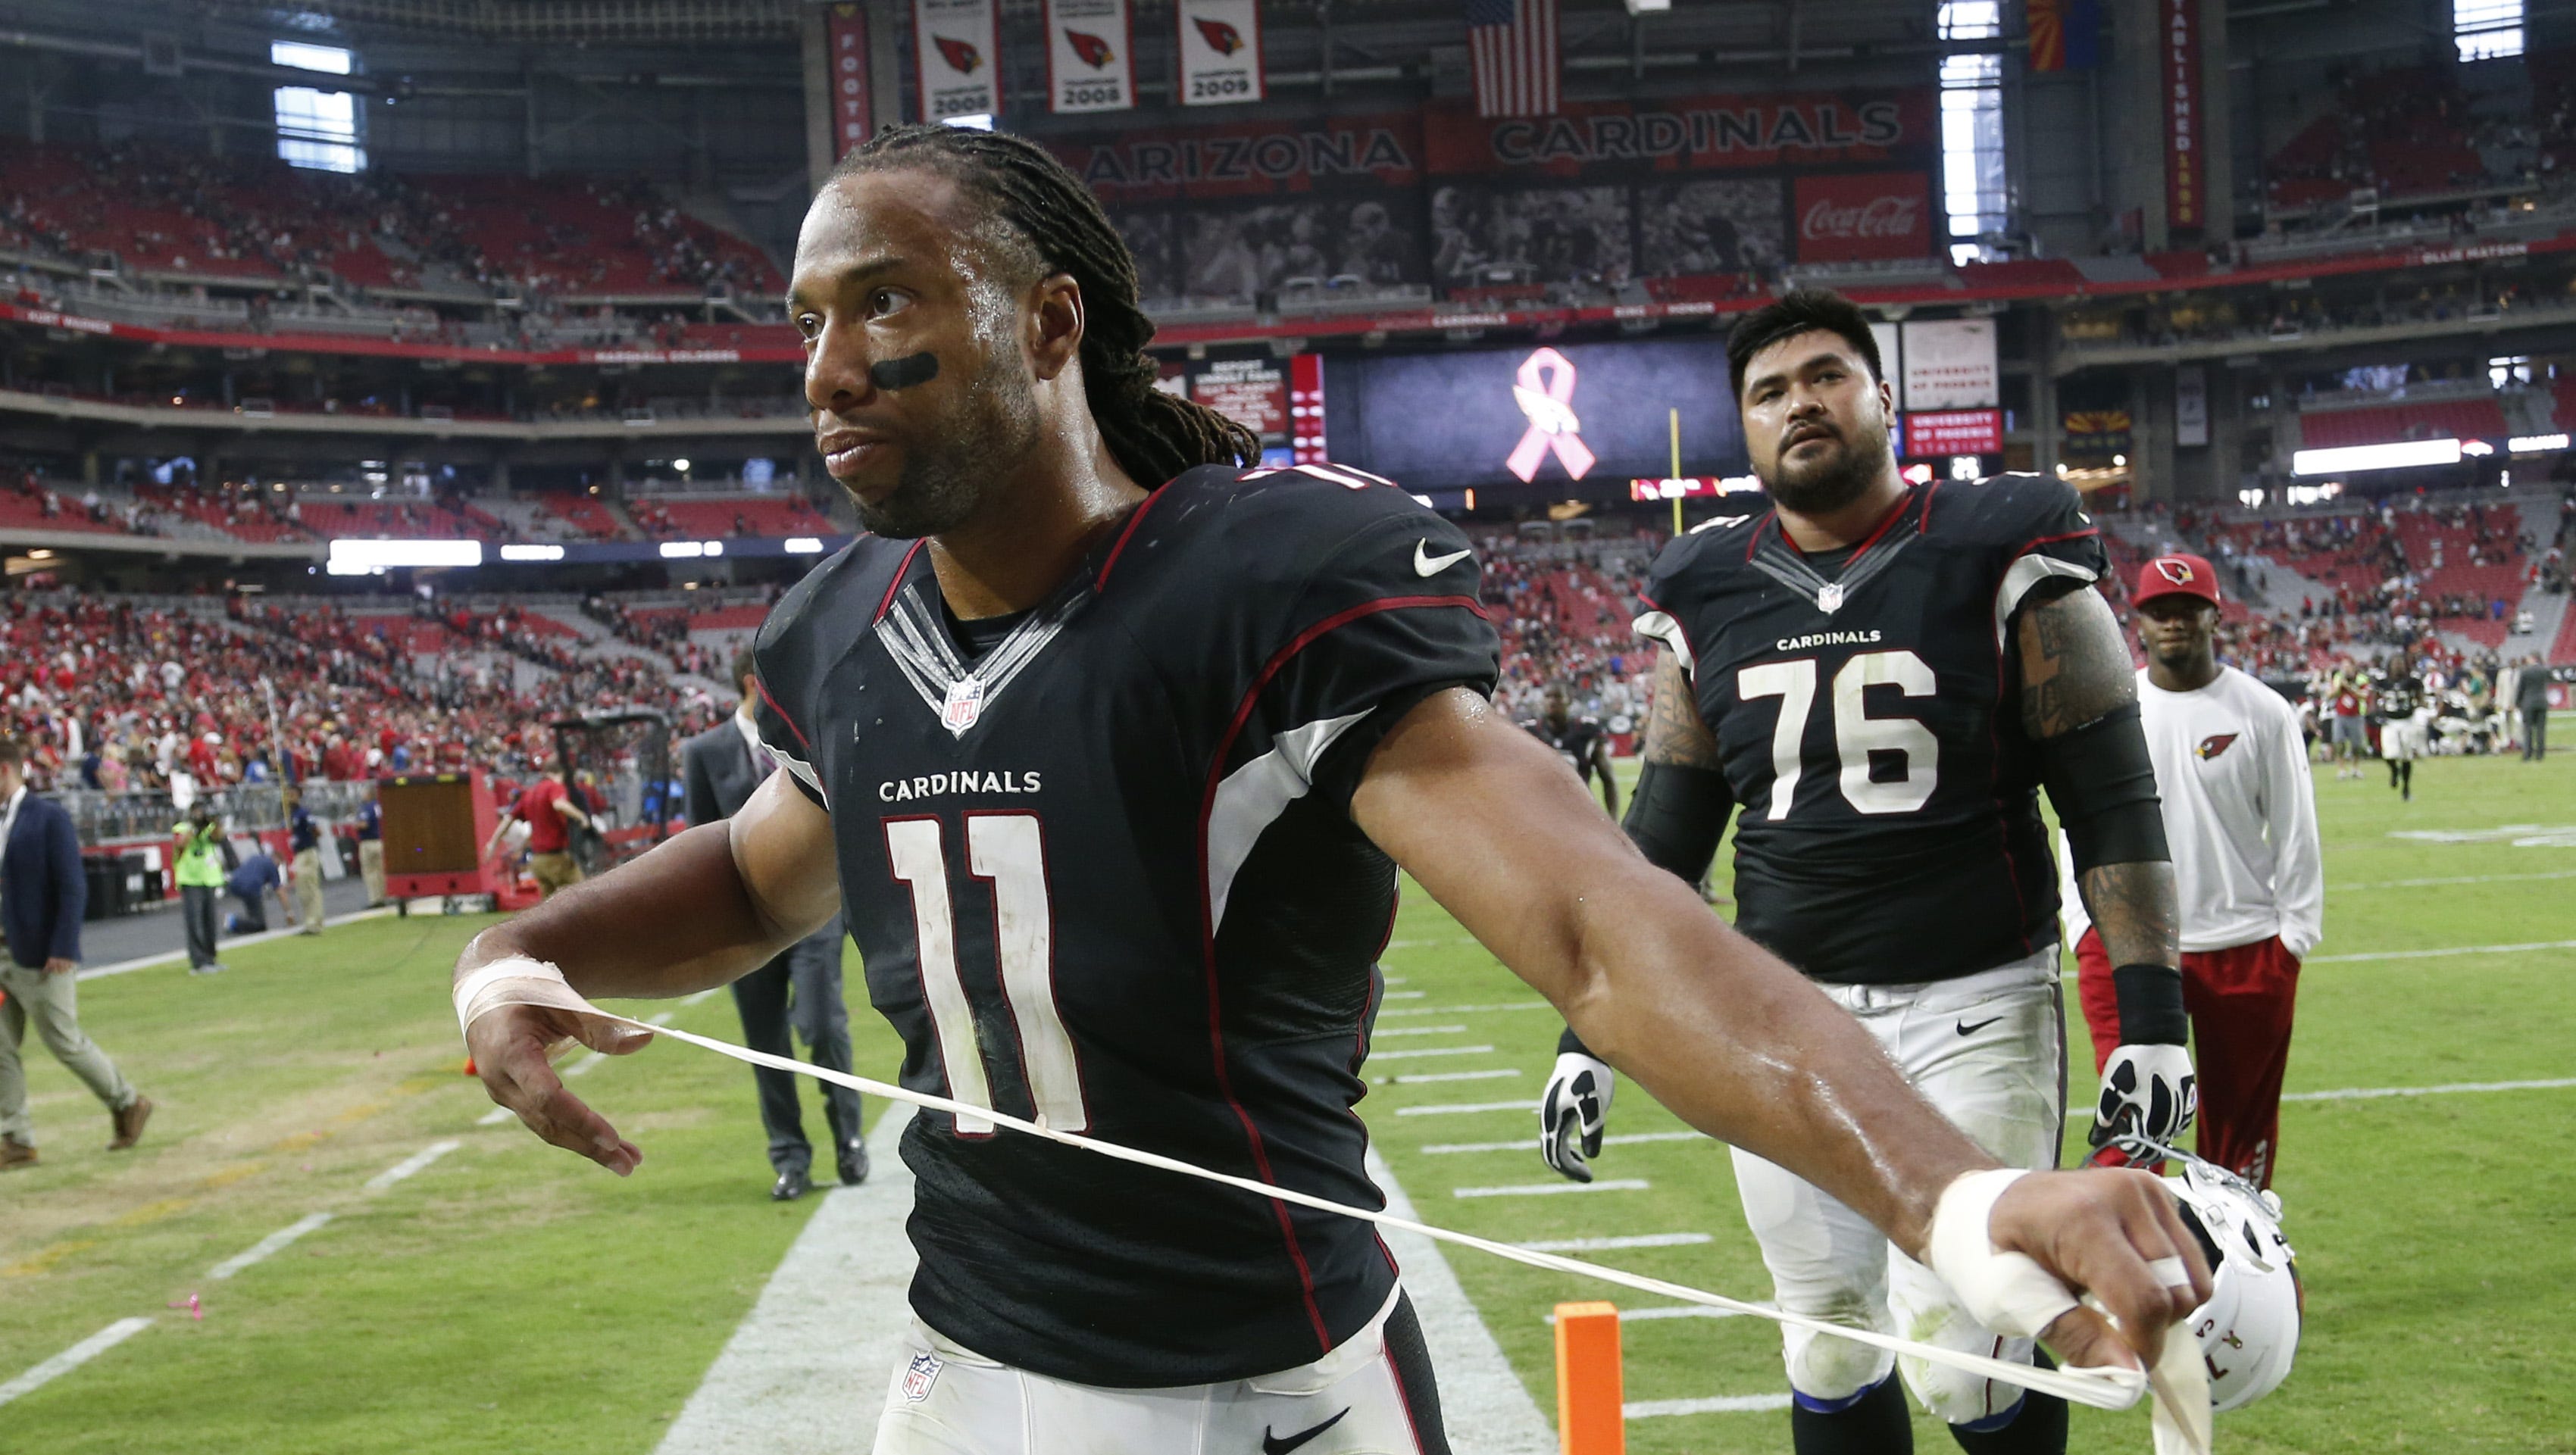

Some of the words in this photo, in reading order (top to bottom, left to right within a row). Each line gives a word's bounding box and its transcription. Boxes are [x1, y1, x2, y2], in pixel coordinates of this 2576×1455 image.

[1064, 87, 1121, 105] 2008
[1193, 79, 1249, 97] 2009
[934, 94, 989, 114] 2008
[1492, 101, 1900, 164] CARDINALS
[1086, 127, 1414, 186] ARIZONA
[1802, 195, 1921, 241] Coca-Cola
[1912, 412, 1993, 428] UNIVERSITY
[1776, 629, 1882, 651] CARDINALS
[949, 701, 975, 723] NFL
[1737, 649, 1939, 821] 76
[879, 770, 1042, 802] CARDINALS
[880, 809, 1092, 1139] 11
[905, 1372, 927, 1394] NFL
